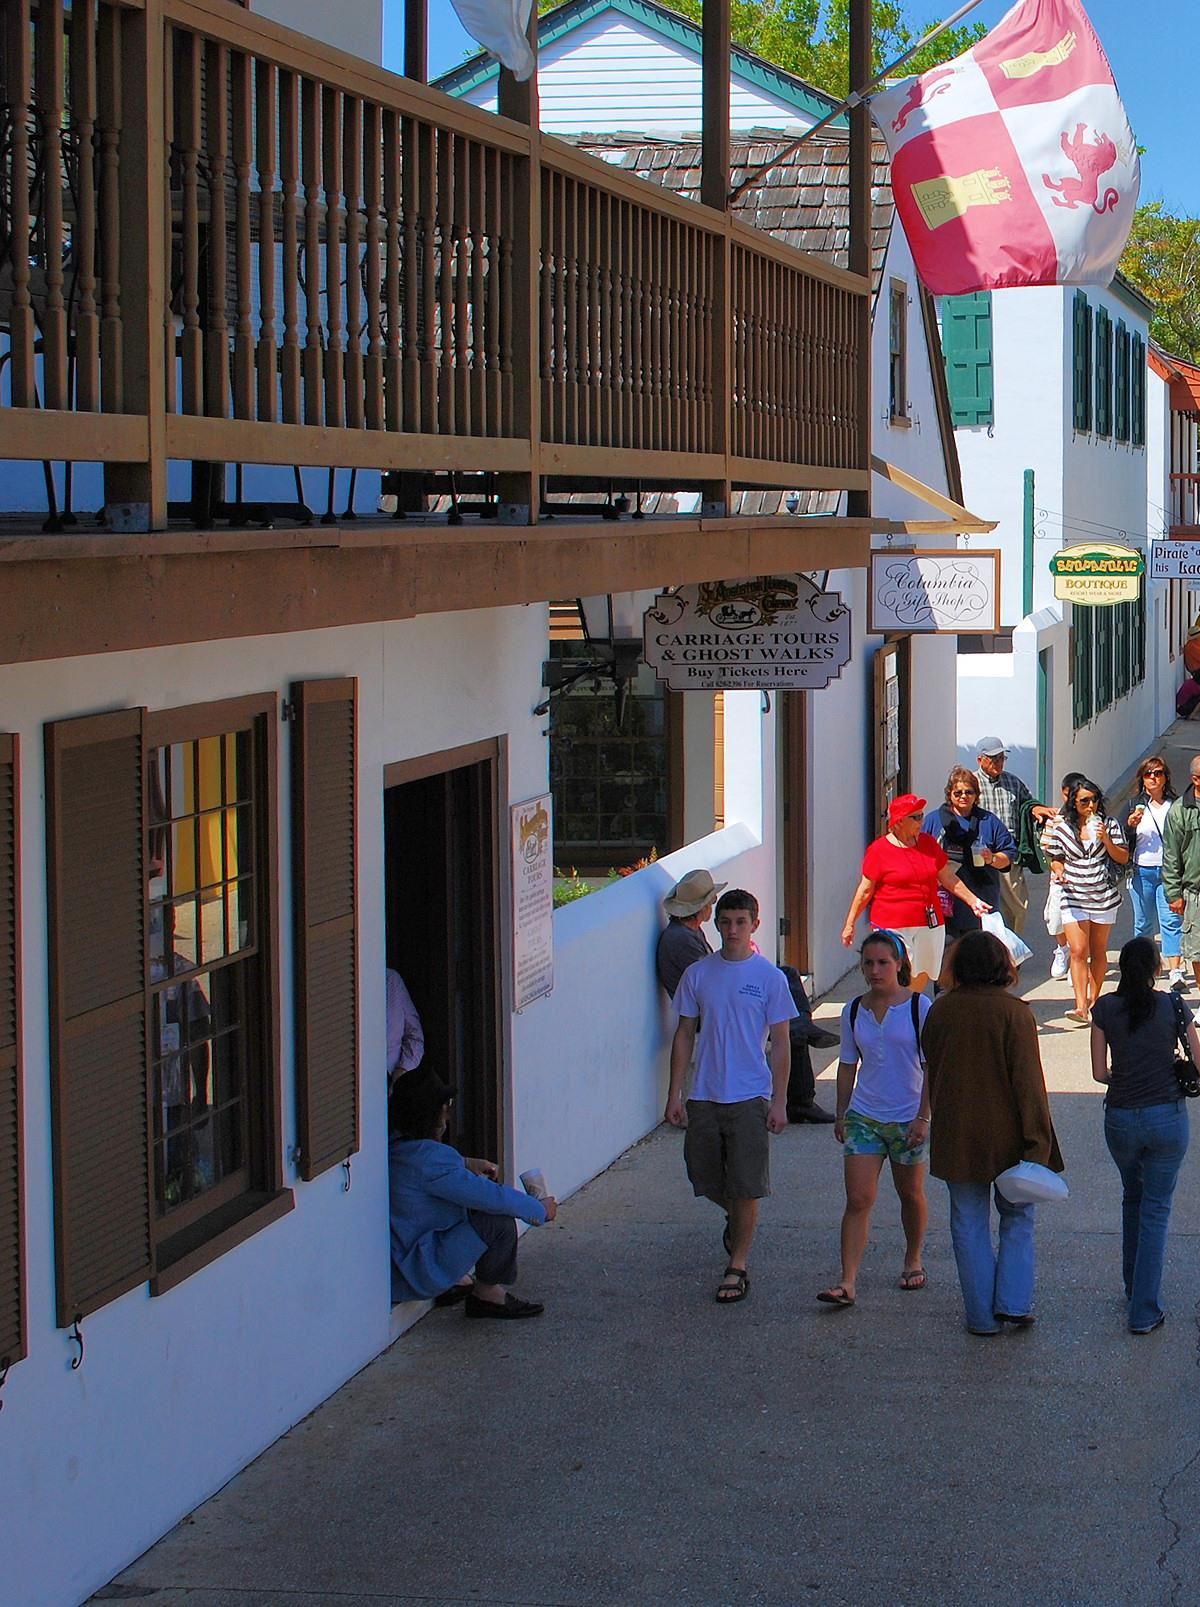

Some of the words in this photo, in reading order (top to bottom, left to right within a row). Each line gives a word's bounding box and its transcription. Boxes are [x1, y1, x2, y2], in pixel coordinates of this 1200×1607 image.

[1155, 547, 1189, 559] Pirate
[1056, 559, 1138, 572] SHOPAHOLIC
[1155, 563, 1169, 573] his
[894, 571, 975, 590] Columbia
[1065, 579, 1128, 590] BOUTIQUE
[902, 591, 930, 612] Gift
[931, 591, 965, 611] Shop
[655, 633, 765, 647] CARRIAGE
[770, 632, 840, 645] TOURS
[661, 650, 676, 661] &
[683, 649, 752, 661] GHOST
[760, 648, 834, 660] WALKS
[687, 667, 714, 679] Buy
[719, 666, 770, 677] Tickets
[774, 666, 808, 676] Here
